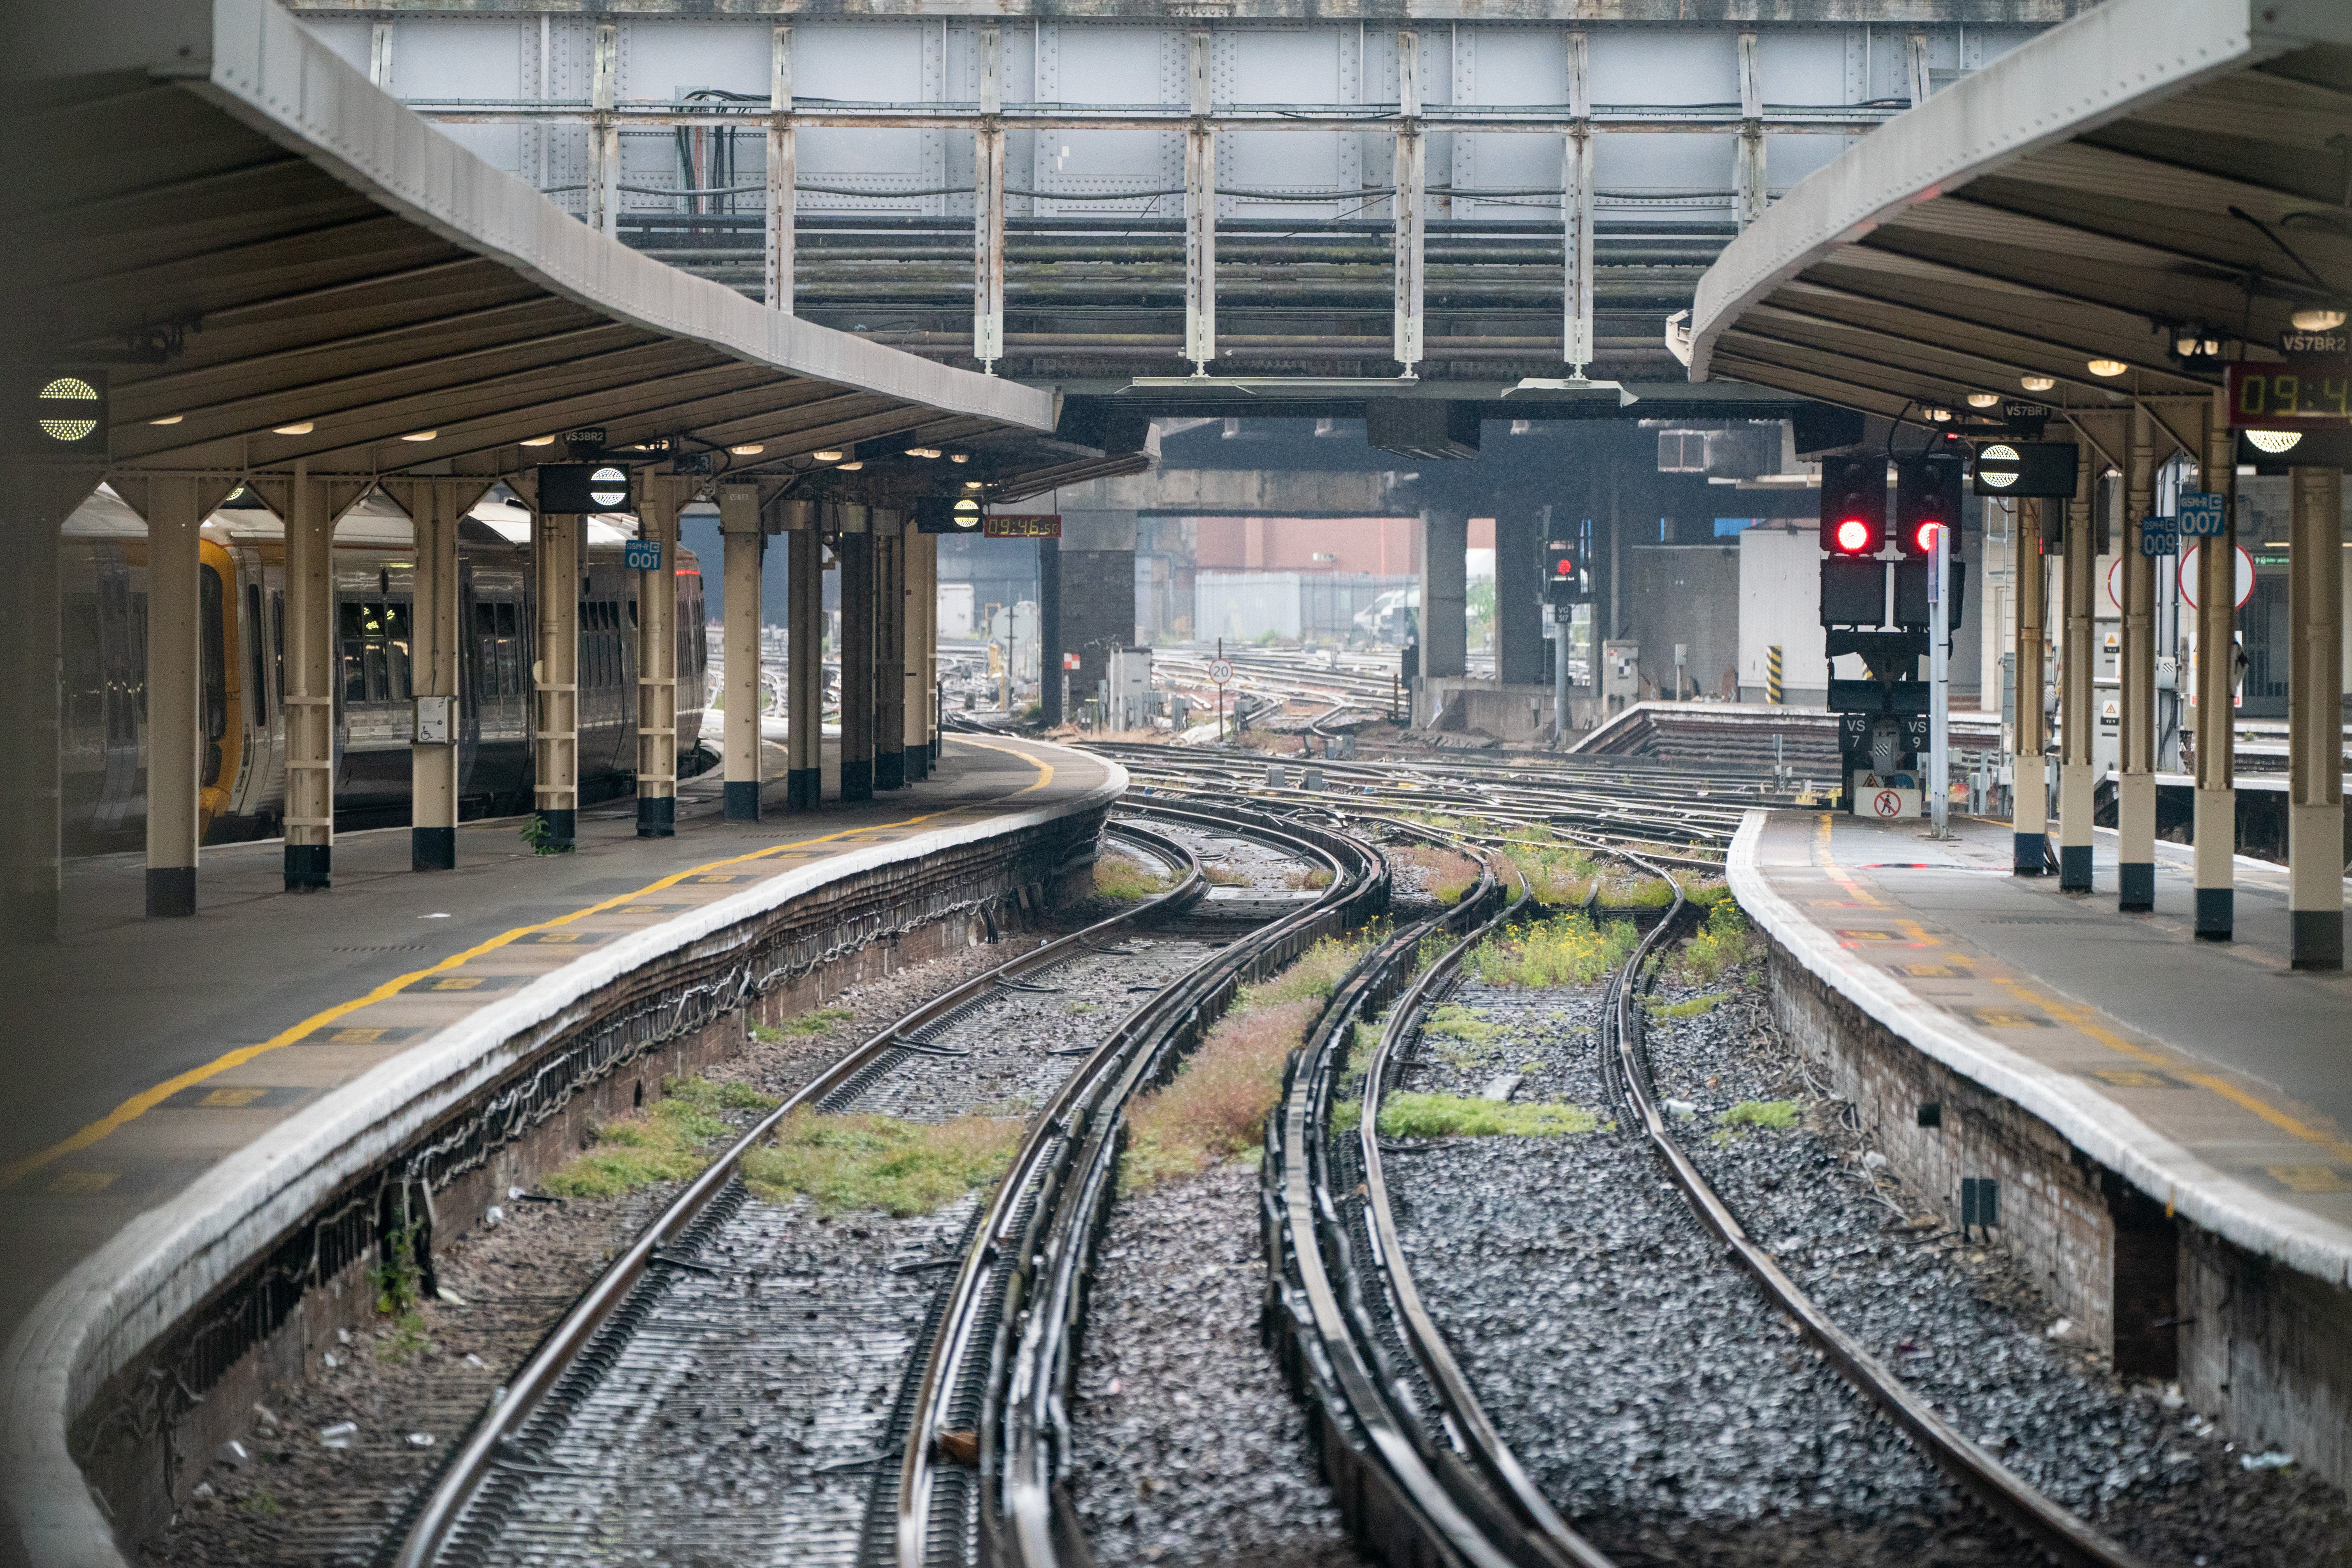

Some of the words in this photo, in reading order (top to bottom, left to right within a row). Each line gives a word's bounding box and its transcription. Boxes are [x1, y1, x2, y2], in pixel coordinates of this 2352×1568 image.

[2283, 337, 2346, 351] VS7BR2
[2006, 406, 2047, 416] VS7BR1
[566, 432, 603, 441] VS3BR2
[2181, 497, 2208, 507] GSM-R
[2182, 511, 2221, 533] 007
[2144, 534, 2176, 555] 009
[629, 553, 657, 568] 001
[1214, 666, 1228, 677] 20
[1847, 720, 1865, 731] VS
[1908, 721, 1927, 733] VS
[1852, 736, 1860, 747] 7
[1913, 737, 1921, 748] 9
